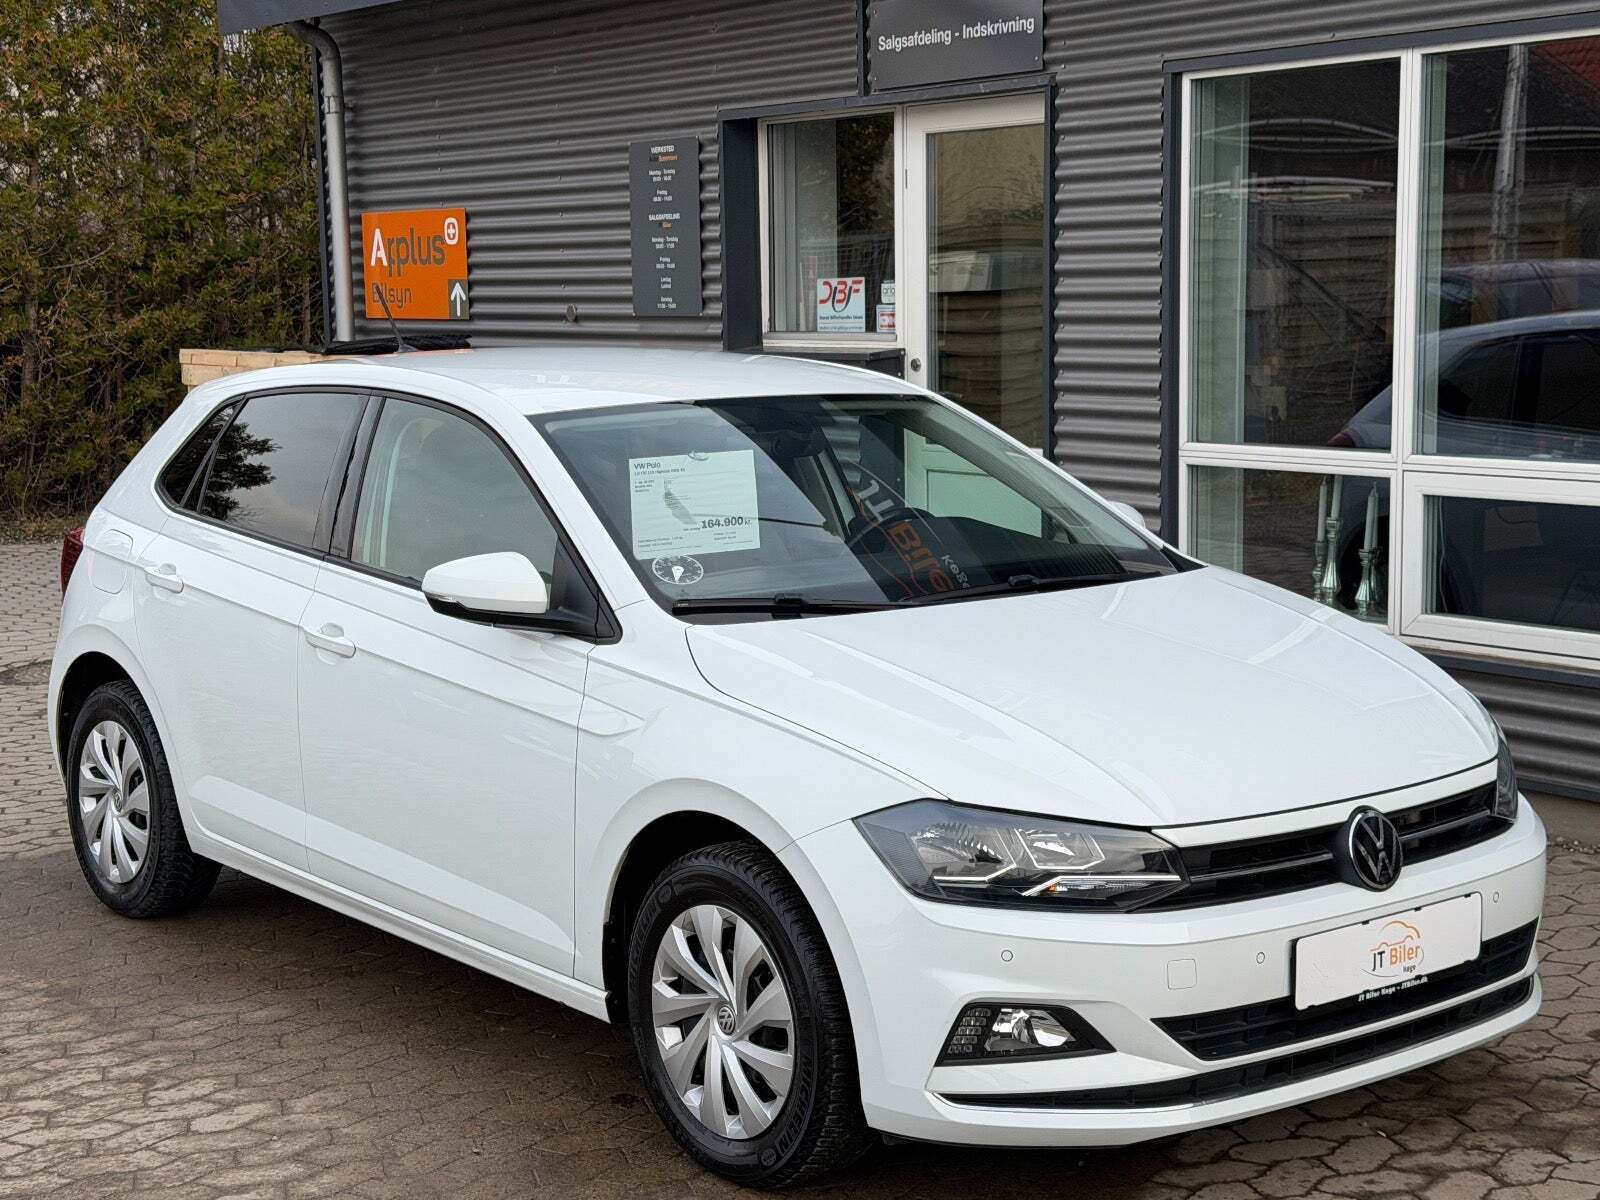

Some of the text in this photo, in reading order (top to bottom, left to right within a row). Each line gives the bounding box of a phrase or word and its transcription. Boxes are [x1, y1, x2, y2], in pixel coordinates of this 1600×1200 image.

[878, 28, 951, 52] Salgsafdeling
[962, 16, 1035, 39] Indskrivning
[701, 516, 744, 529] 164.900
[1372, 945, 1420, 972] JT Biler
